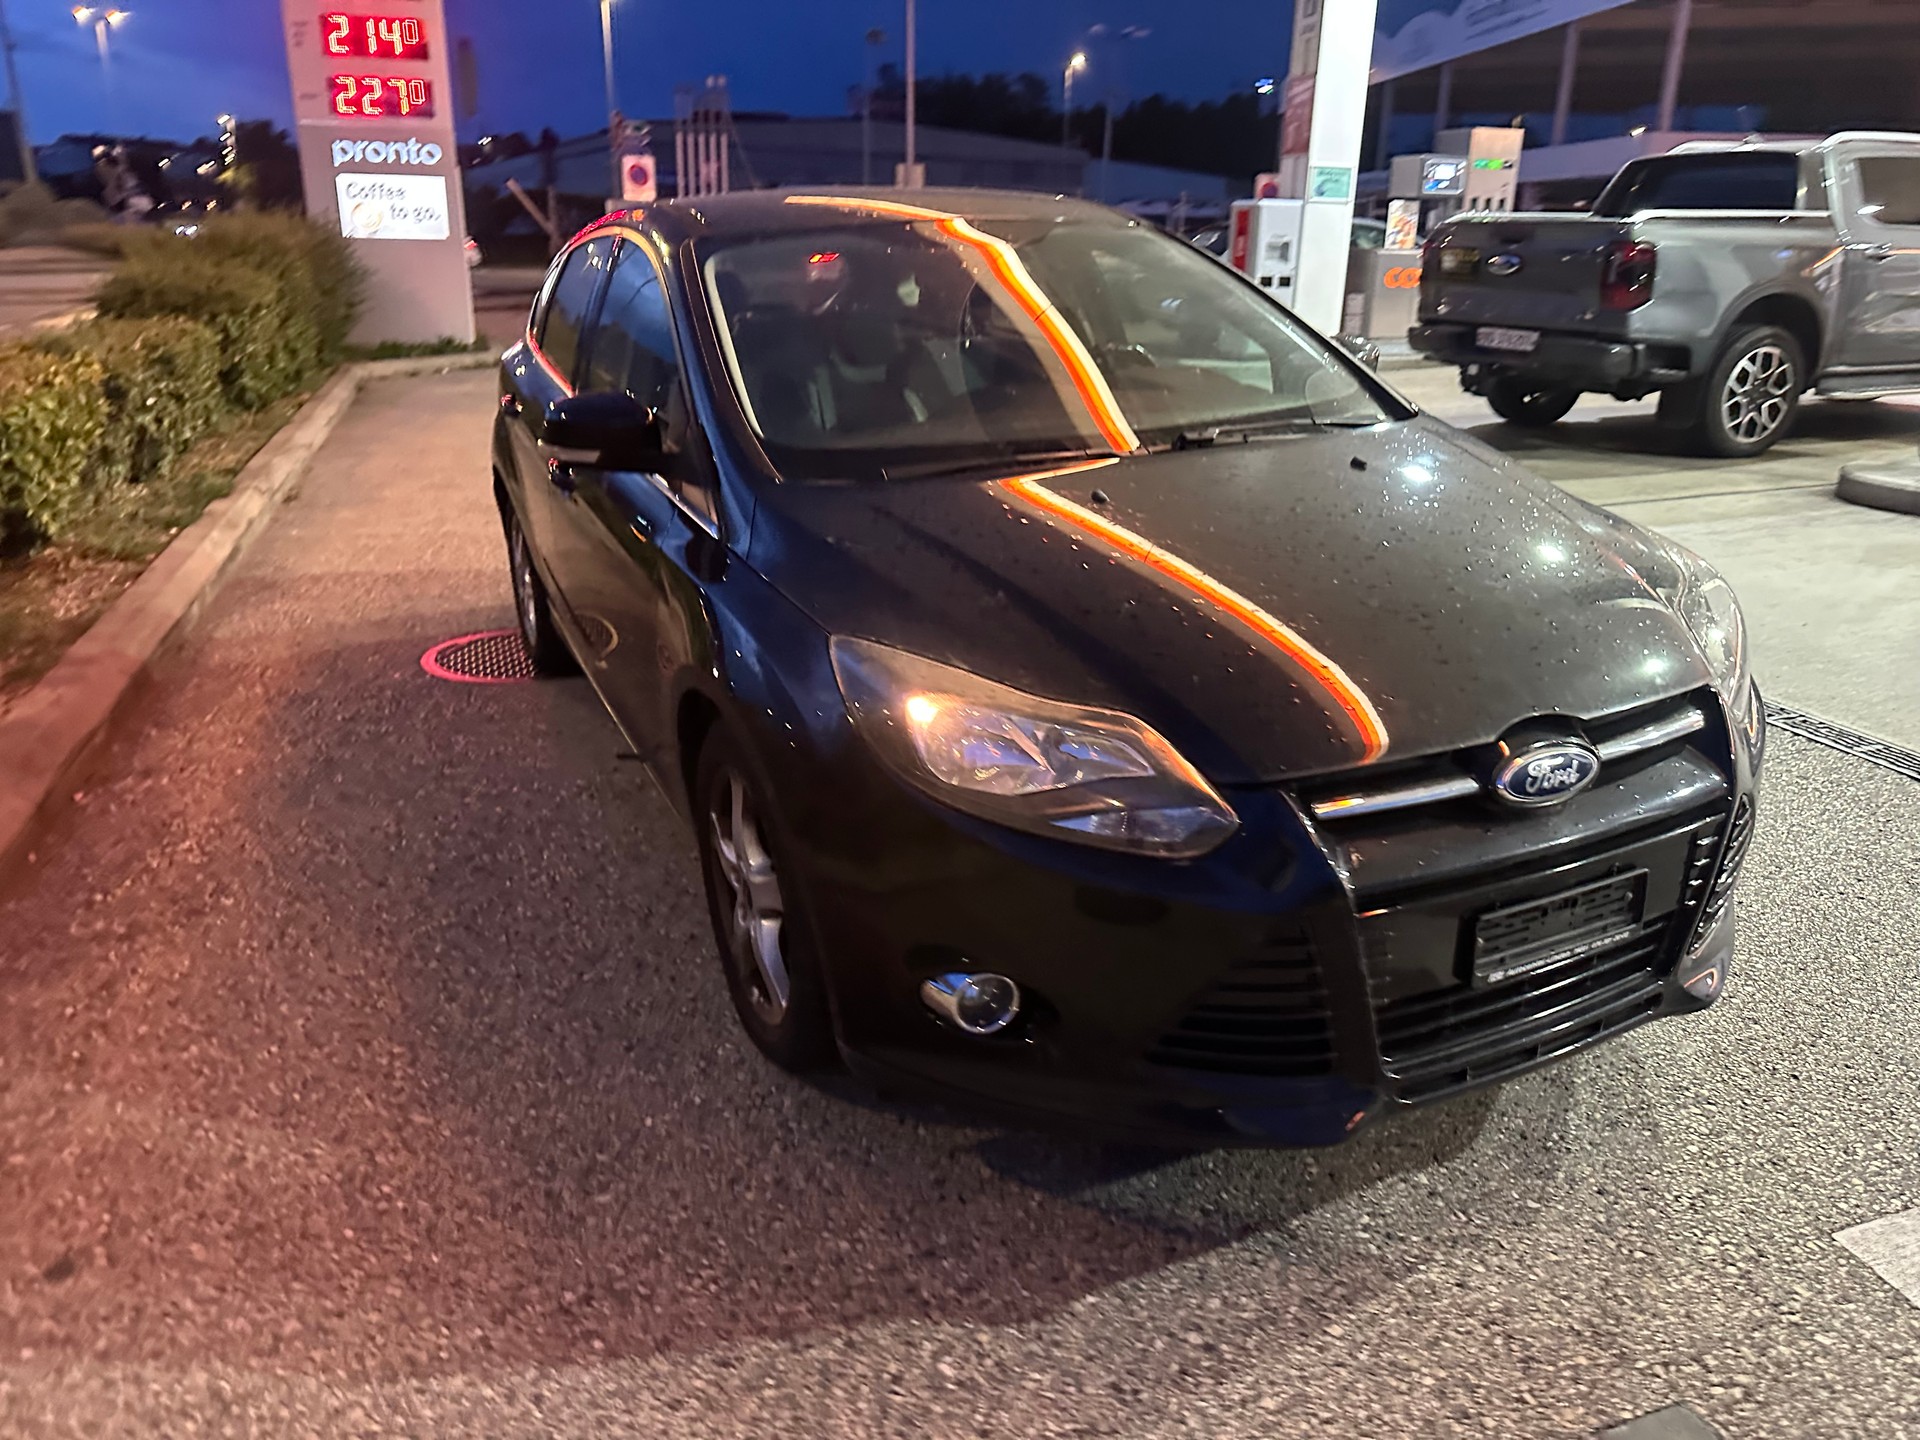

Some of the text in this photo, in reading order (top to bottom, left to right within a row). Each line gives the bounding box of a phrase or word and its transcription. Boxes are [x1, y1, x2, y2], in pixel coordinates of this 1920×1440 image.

[331, 137, 442, 167] pronto
[346, 182, 406, 200] Coffee
[389, 203, 409, 220] to
[1526, 755, 1581, 795] Ford
